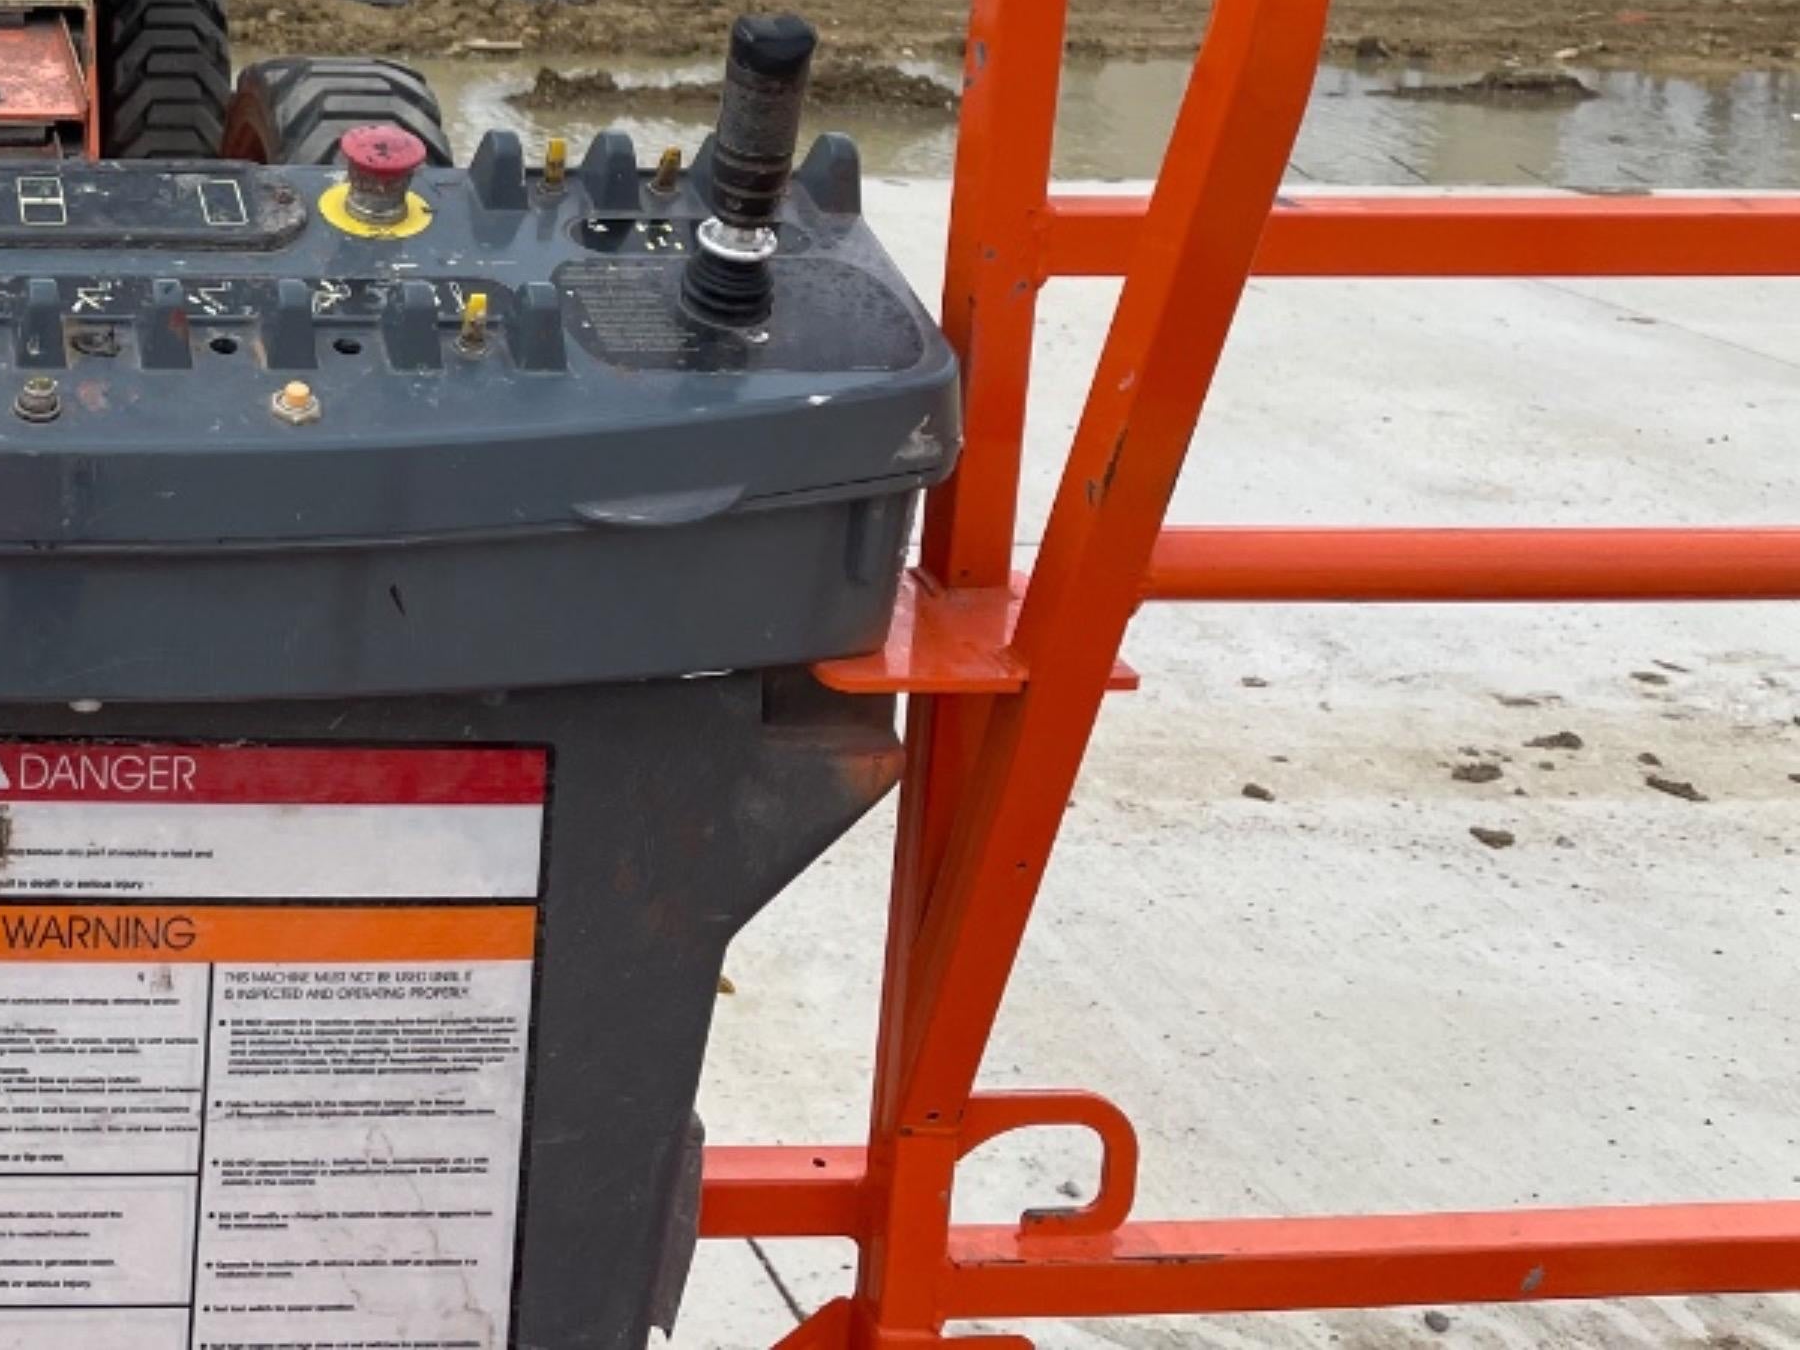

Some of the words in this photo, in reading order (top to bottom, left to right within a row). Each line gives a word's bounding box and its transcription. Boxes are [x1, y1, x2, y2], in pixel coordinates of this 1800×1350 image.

[19, 754, 197, 791] DANGER
[30, 879, 60, 889] death
[78, 880, 111, 889] serious
[1, 914, 197, 951] WARNING
[224, 970, 250, 983] THIS
[252, 970, 309, 983] MACHINE
[315, 970, 346, 983] MUST
[237, 986, 304, 1000] INSPECTED
[306, 986, 333, 1000] AND
[337, 986, 405, 1000] OPERATING
